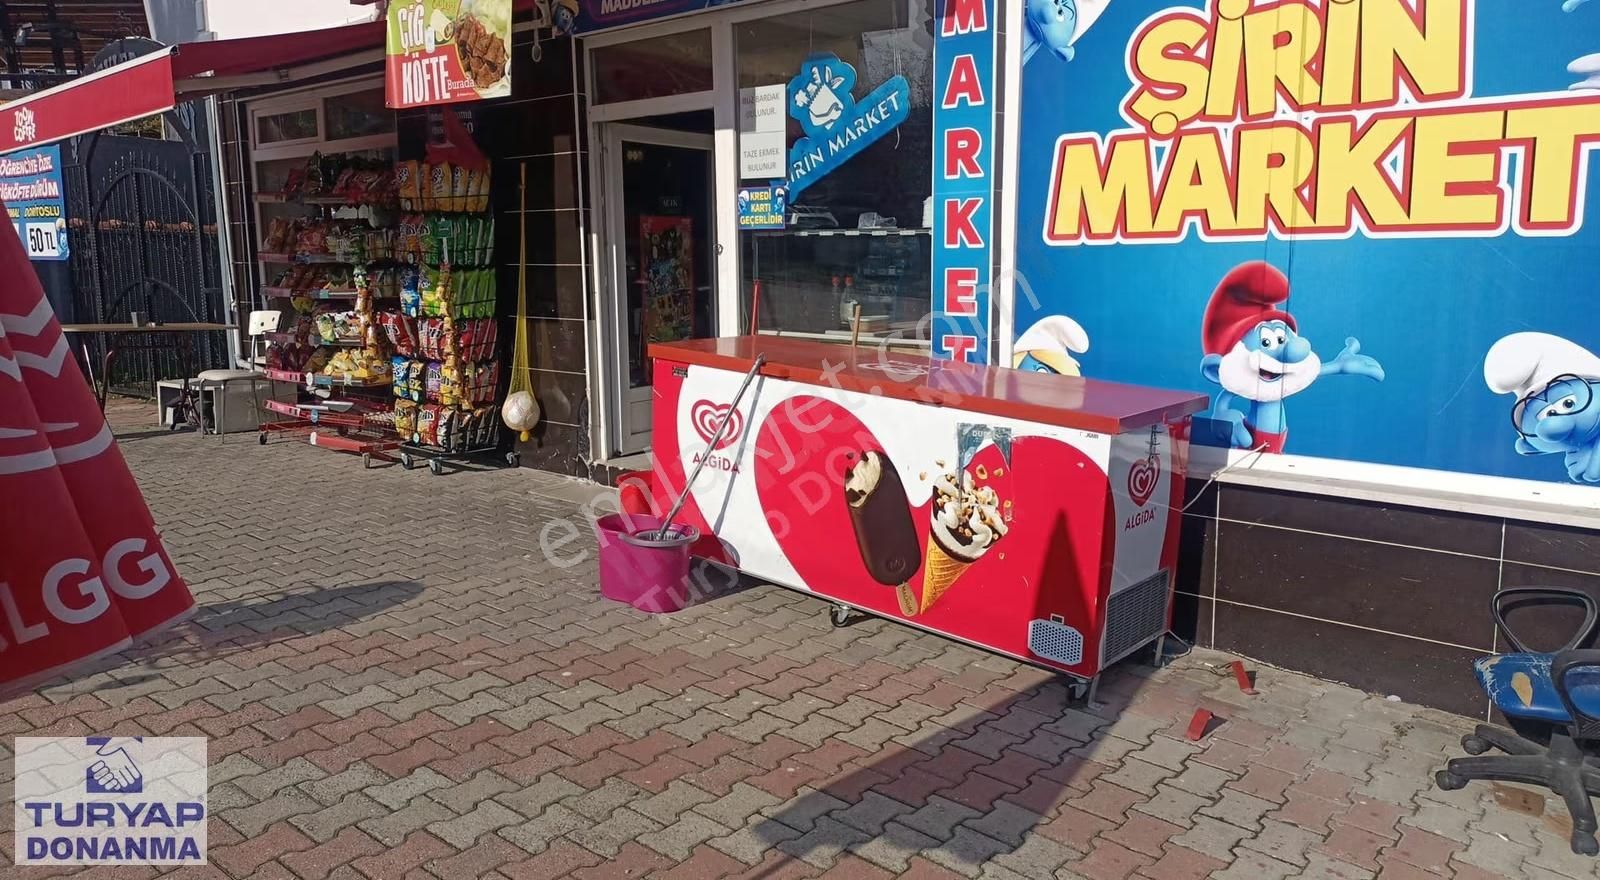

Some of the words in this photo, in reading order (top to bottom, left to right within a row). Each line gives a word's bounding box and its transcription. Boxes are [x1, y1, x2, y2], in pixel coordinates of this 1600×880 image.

[402, 52, 451, 105] KÖFTE
[447, 78, 475, 90] Burada
[755, 92, 780, 103] BARDAK
[828, 91, 899, 157] MARKET
[37, 154, 53, 172] ÖZEL
[744, 150, 758, 159] TAZE
[748, 165, 777, 173] BULUNUR
[1052, 101, 1600, 236] MARKET
[941, 0, 987, 363] MARKET
[750, 189, 771, 200] KREDİ
[740, 214, 783, 227] GEÇERLİDİR
[29, 228, 43, 254] 50
[45, 232, 56, 250] TL
[0, 538, 171, 645] LGG
